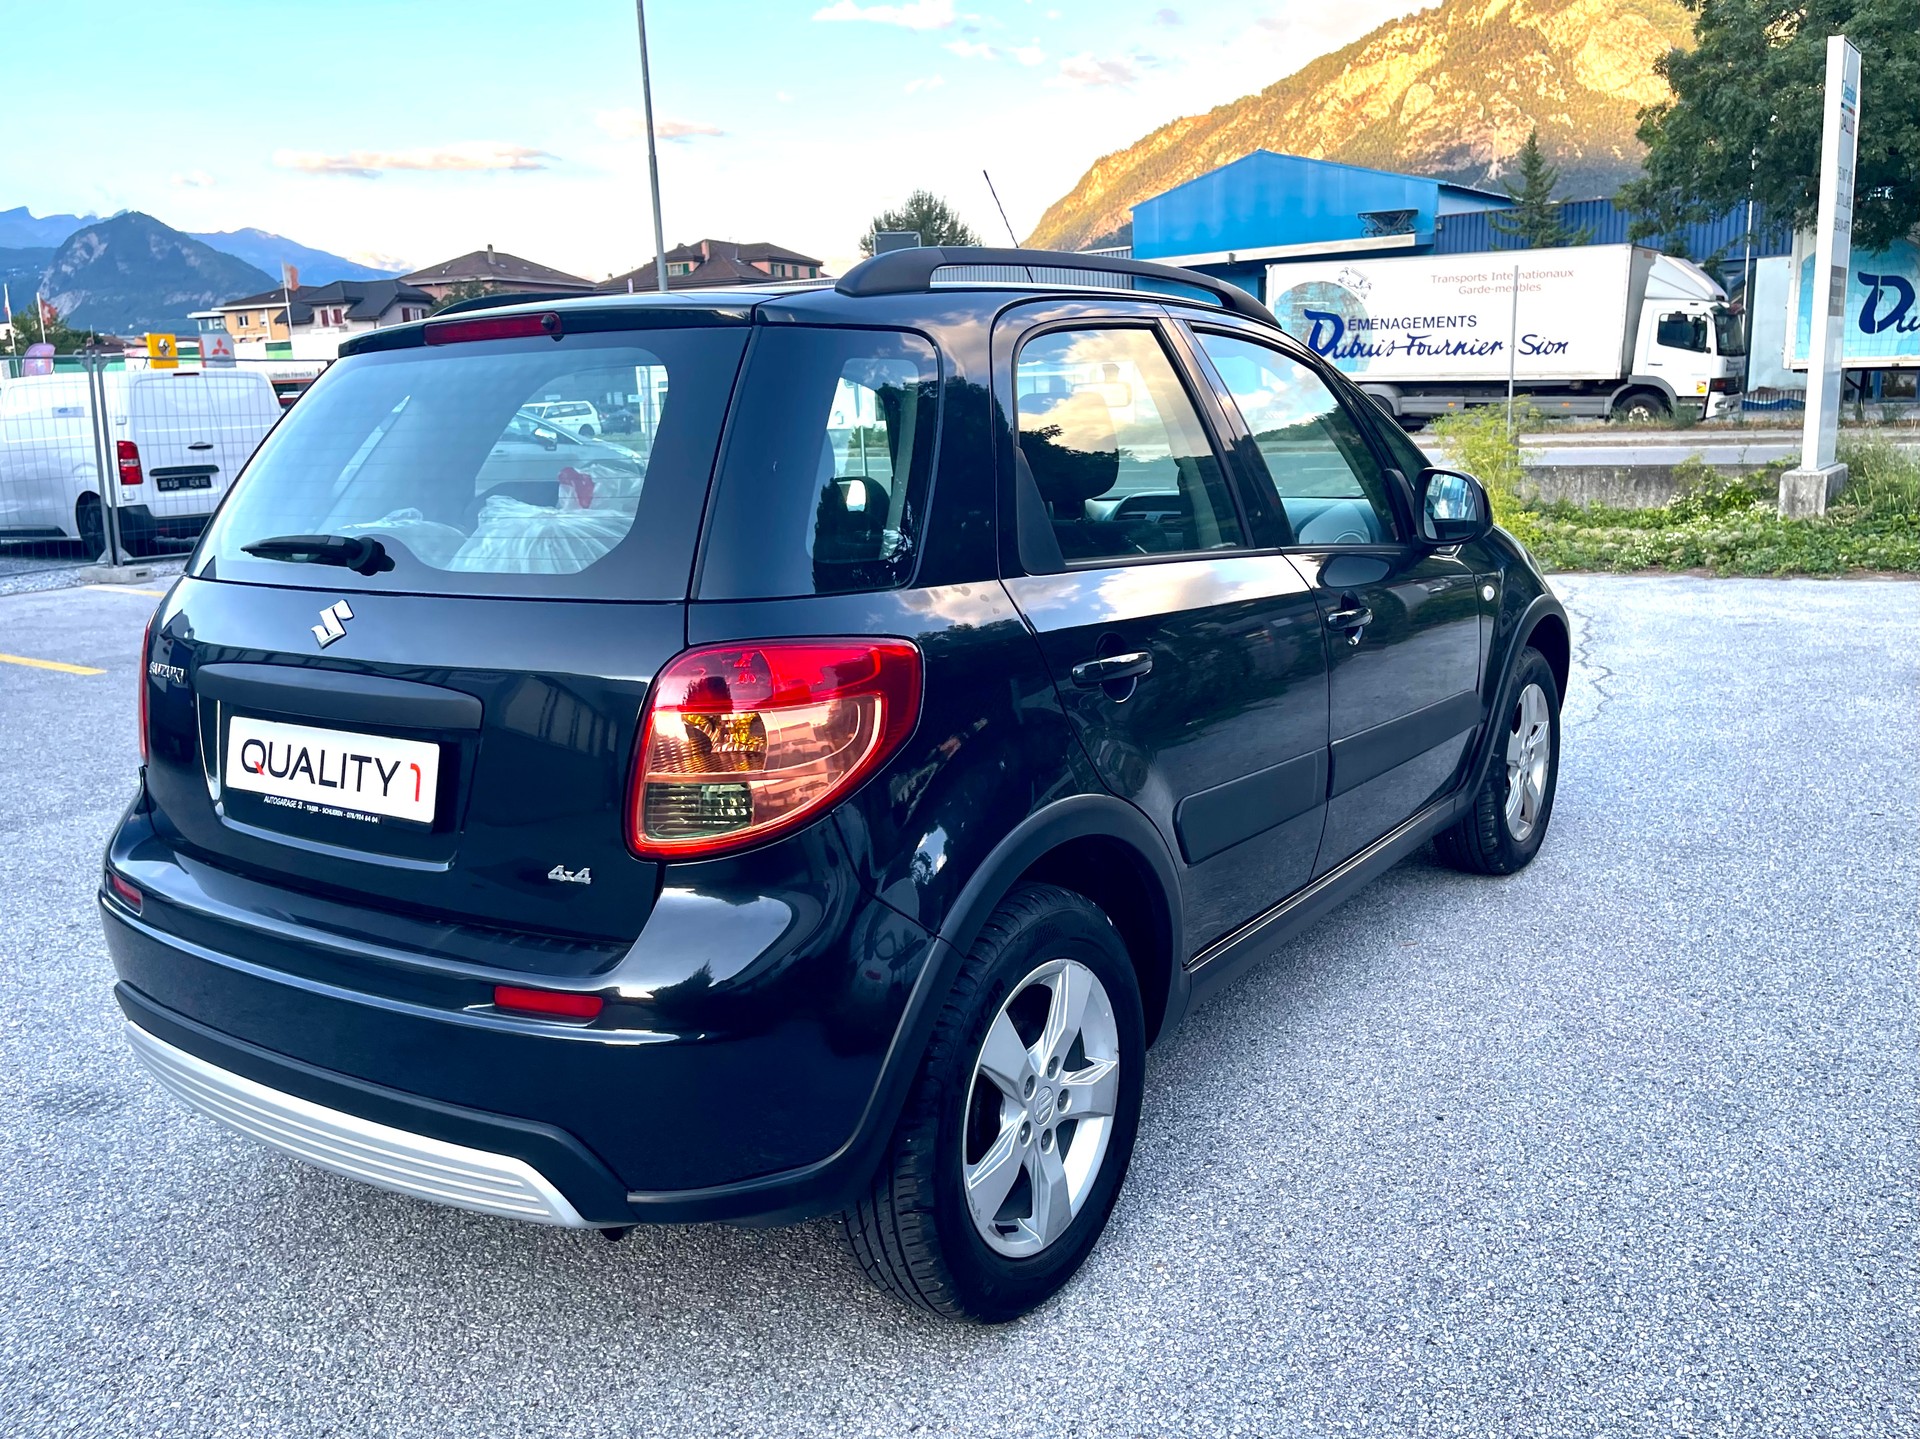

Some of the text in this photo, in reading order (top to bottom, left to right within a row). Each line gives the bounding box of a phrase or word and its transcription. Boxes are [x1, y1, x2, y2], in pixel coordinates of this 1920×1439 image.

[1430, 269, 1575, 285] Transports Intenationaux
[1518, 333, 1569, 356] Sion
[241, 738, 421, 802] QUALITY 1
[263, 795, 297, 808] AUTOGARAGE
[547, 864, 592, 885] 4x4
